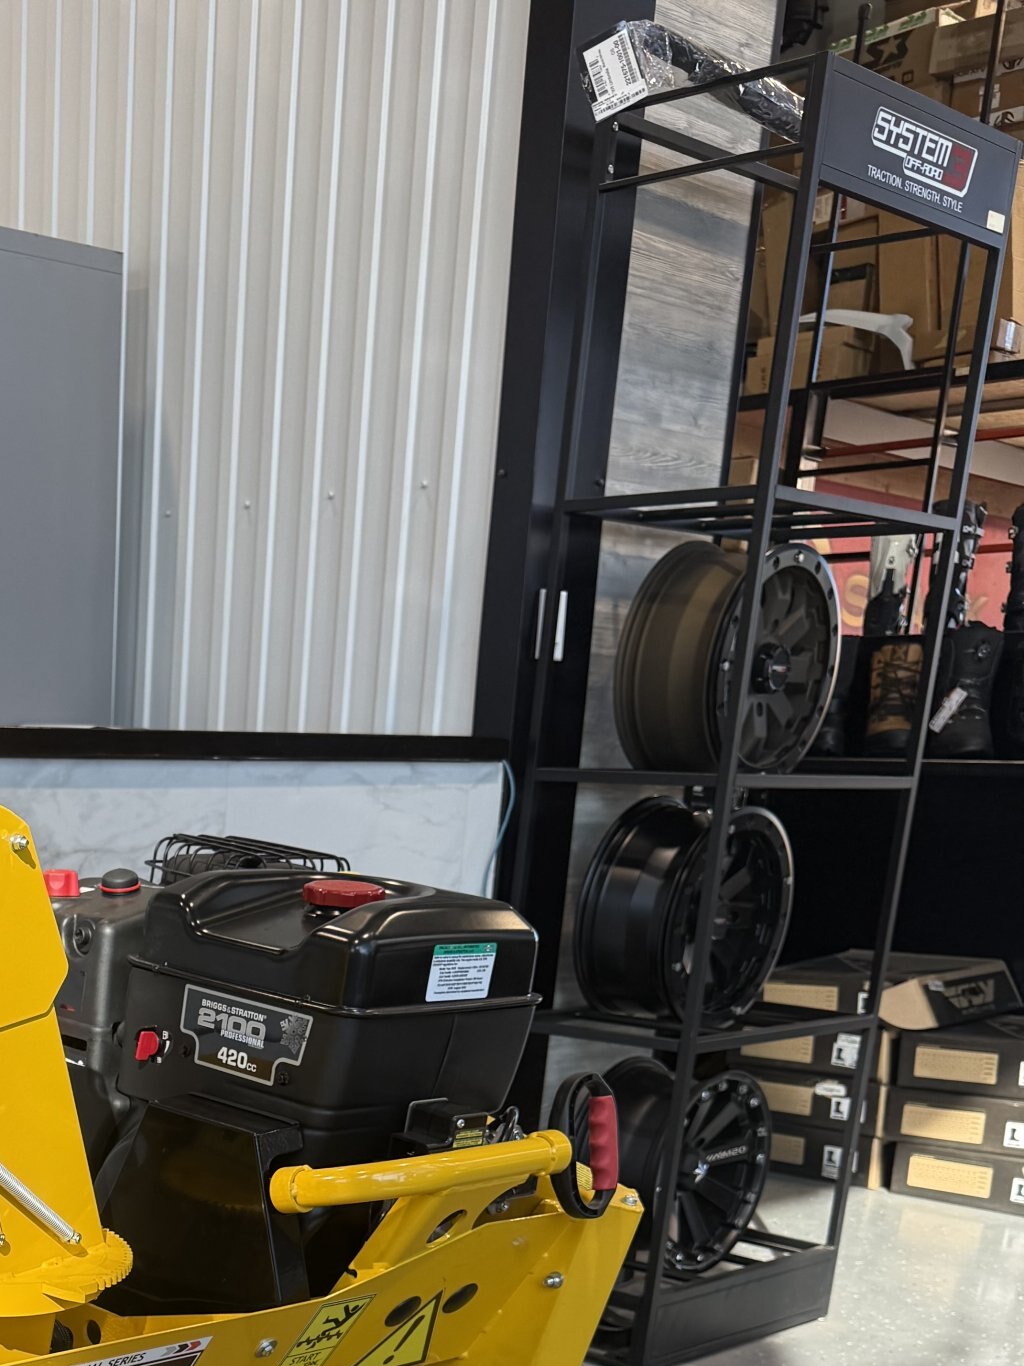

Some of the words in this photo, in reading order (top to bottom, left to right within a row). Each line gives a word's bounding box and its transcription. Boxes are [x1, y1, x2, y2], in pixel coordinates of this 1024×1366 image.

[873, 110, 953, 168] SYSTEM
[904, 155, 944, 181] OFF-ROAD
[942, 195, 963, 214] STYLE
[197, 1007, 266, 1041] 2100
[220, 1029, 264, 1049] PROFESSIONAL
[289, 1352, 322, 1366] START
